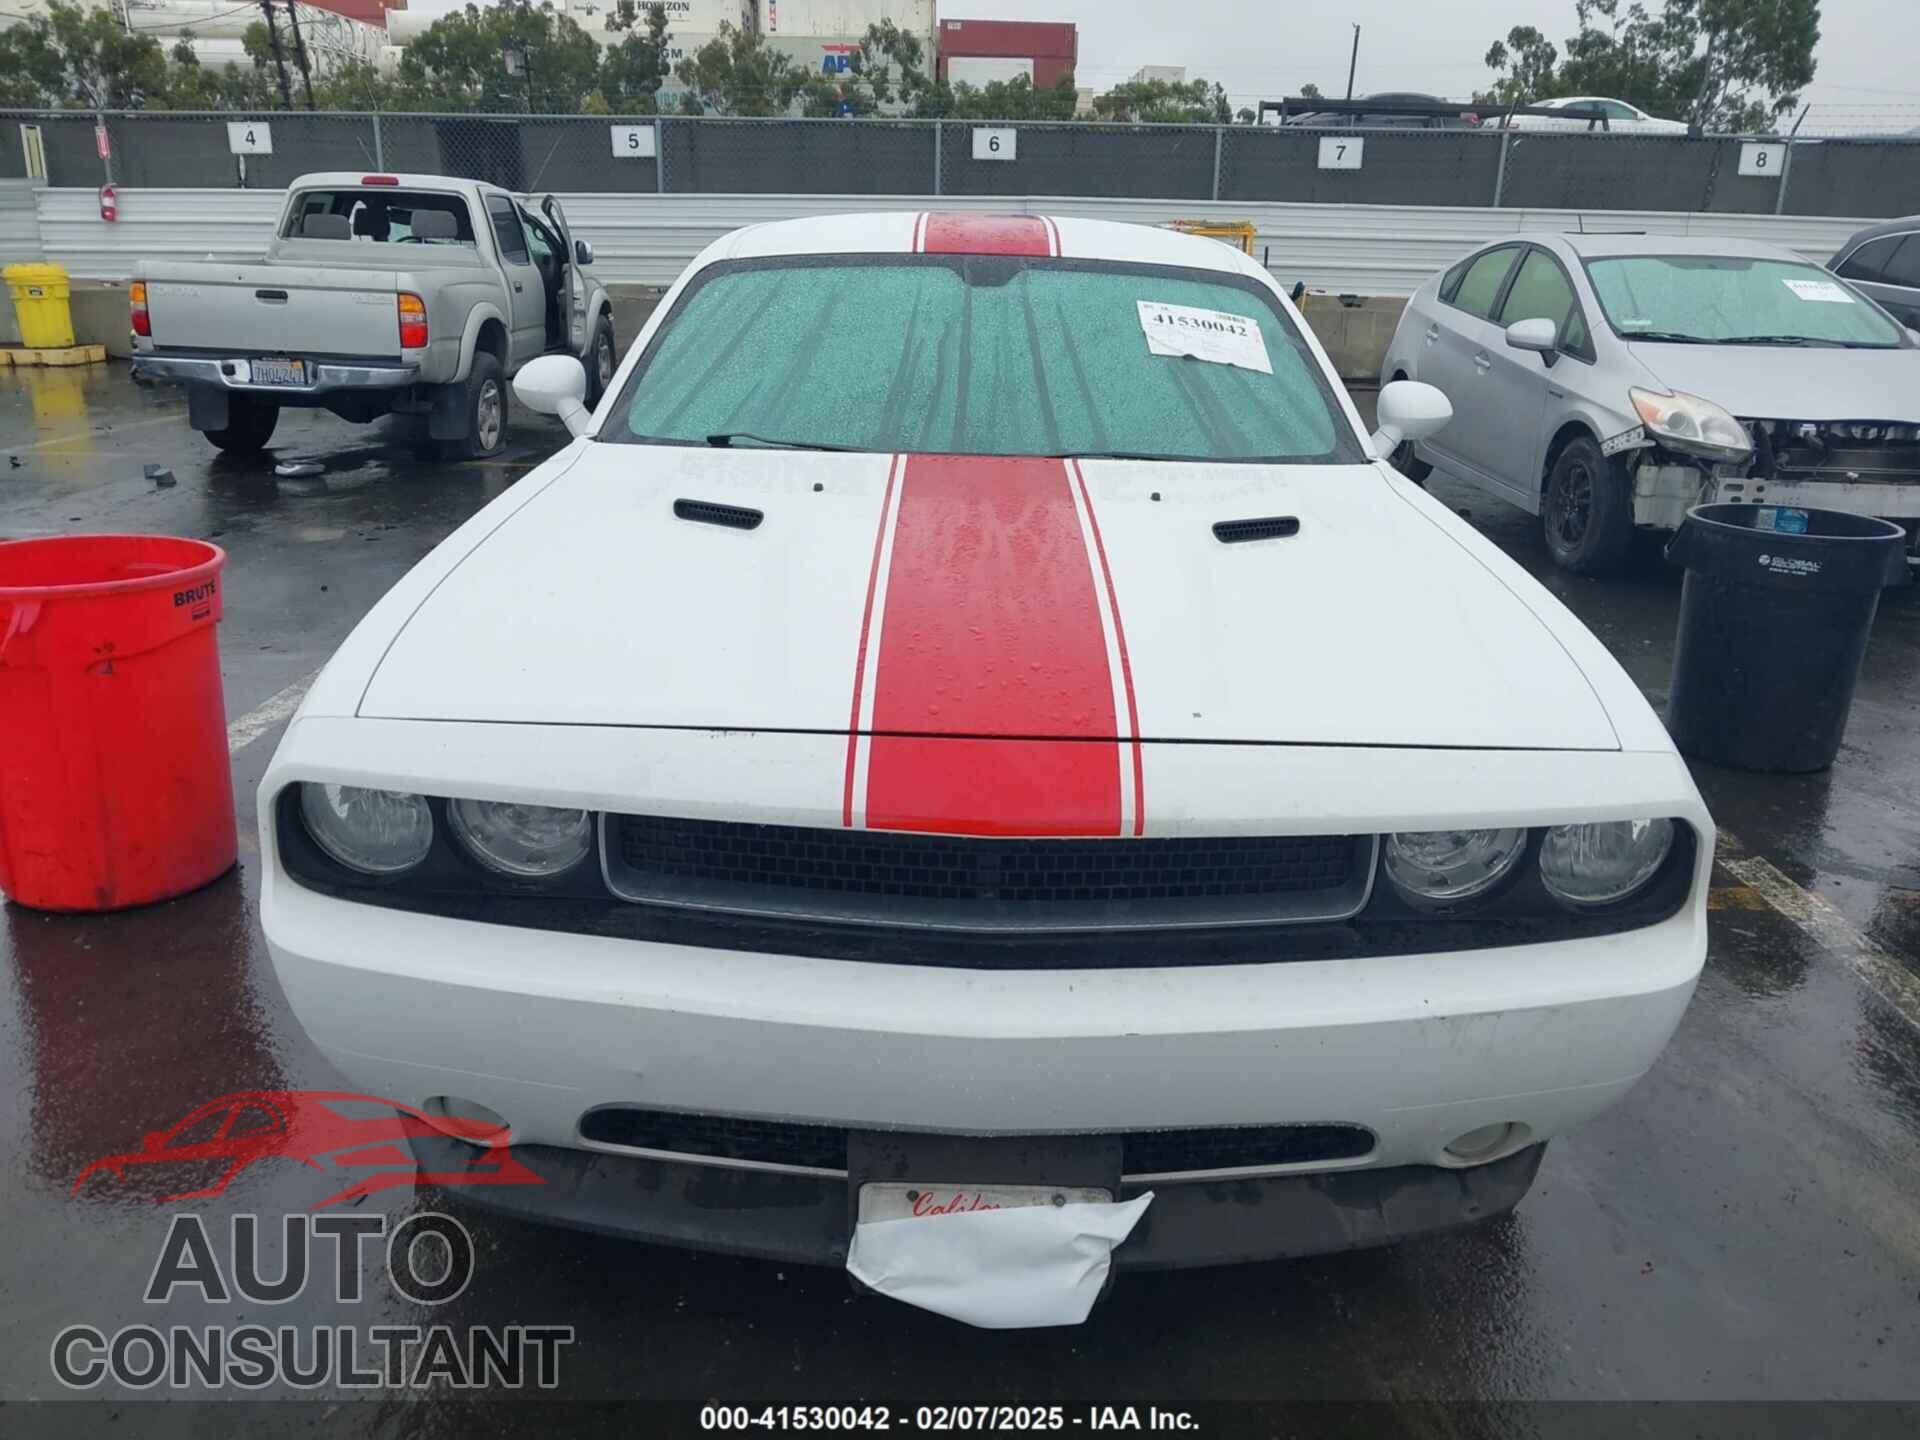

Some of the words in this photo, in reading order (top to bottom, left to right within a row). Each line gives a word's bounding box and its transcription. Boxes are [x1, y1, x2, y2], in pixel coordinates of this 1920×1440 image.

[637, 0, 690, 11] HOIZON
[822, 54, 856, 73] AP
[245, 130, 256, 146] 4
[628, 133, 640, 149] 5
[988, 135, 1000, 152] 6
[1335, 145, 1347, 161] 7
[1756, 151, 1768, 168] 8
[1153, 314, 1248, 337] 41530042
[173, 579, 216, 608] BRUTE
